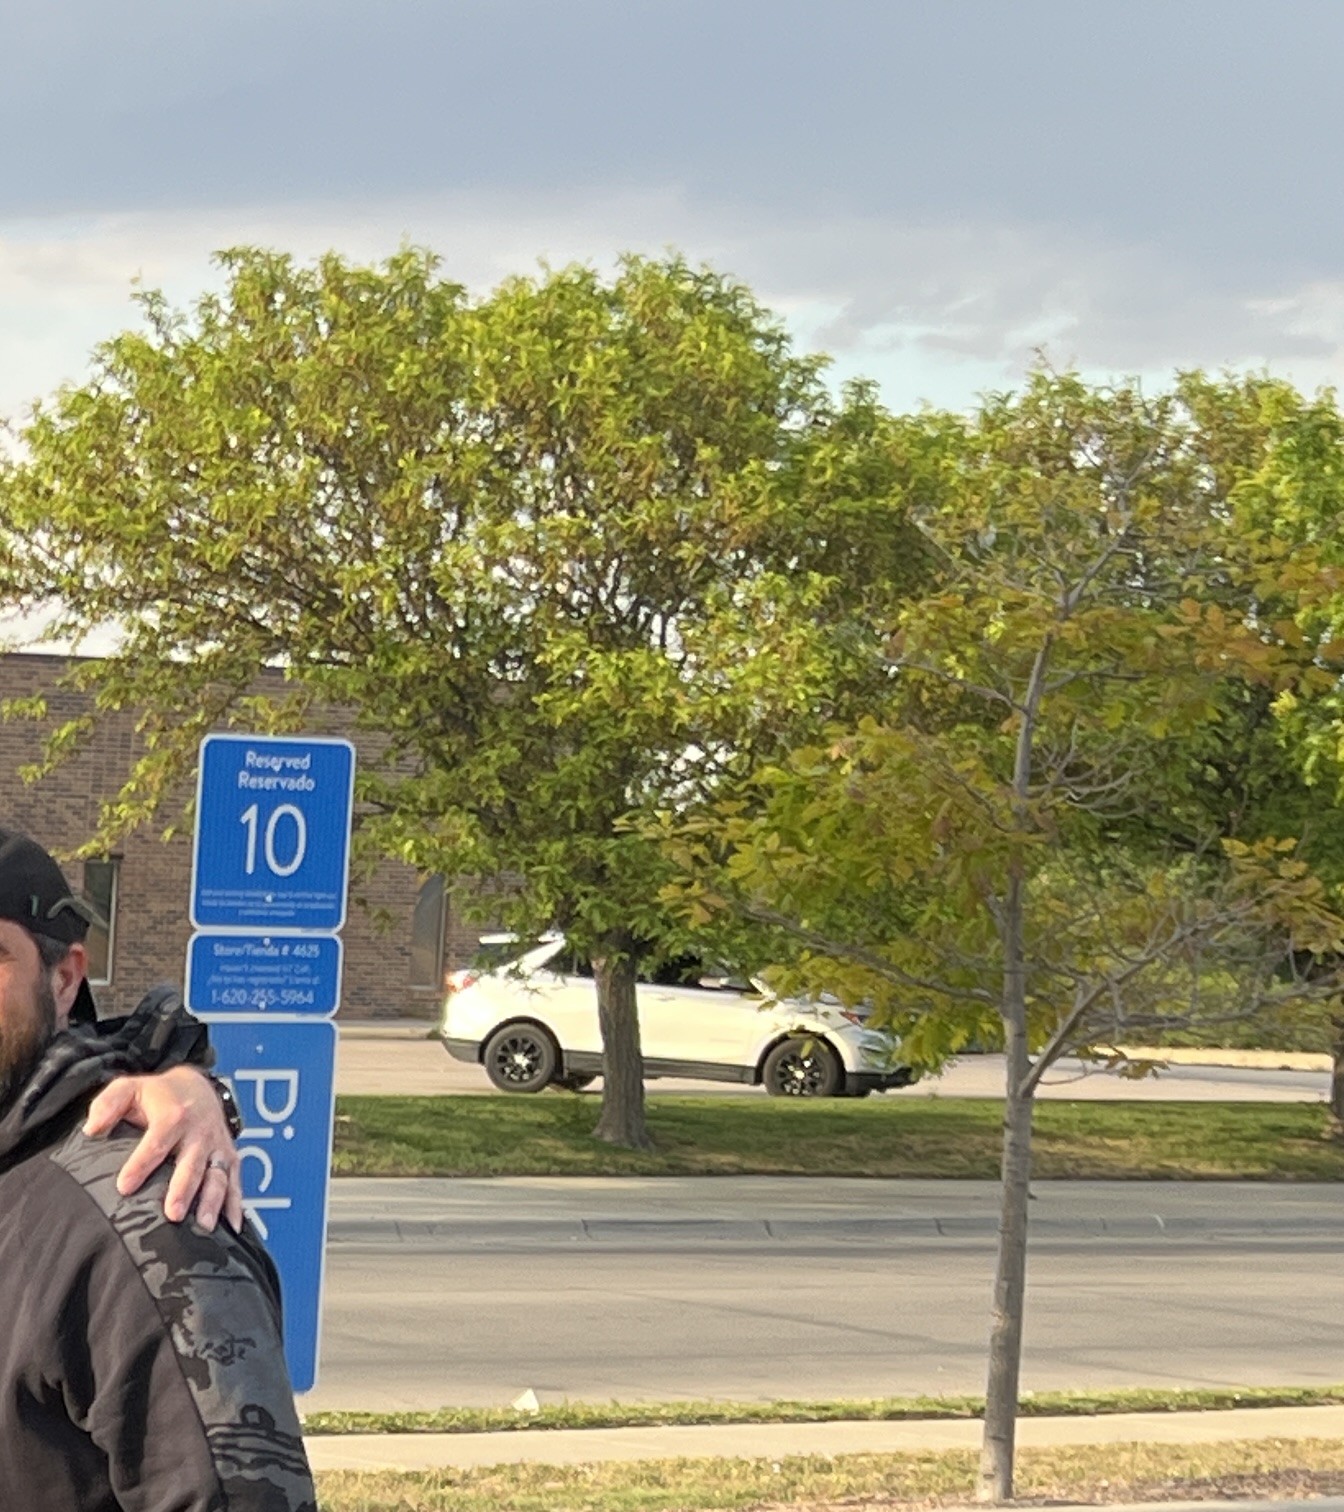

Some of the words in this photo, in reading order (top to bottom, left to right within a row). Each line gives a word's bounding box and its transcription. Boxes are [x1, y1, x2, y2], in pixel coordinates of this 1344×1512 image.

[238, 770, 315, 791] Reservado
[245, 750, 311, 770] Reserved
[240, 803, 307, 877] 10
[234, 1069, 299, 1240] Pick
